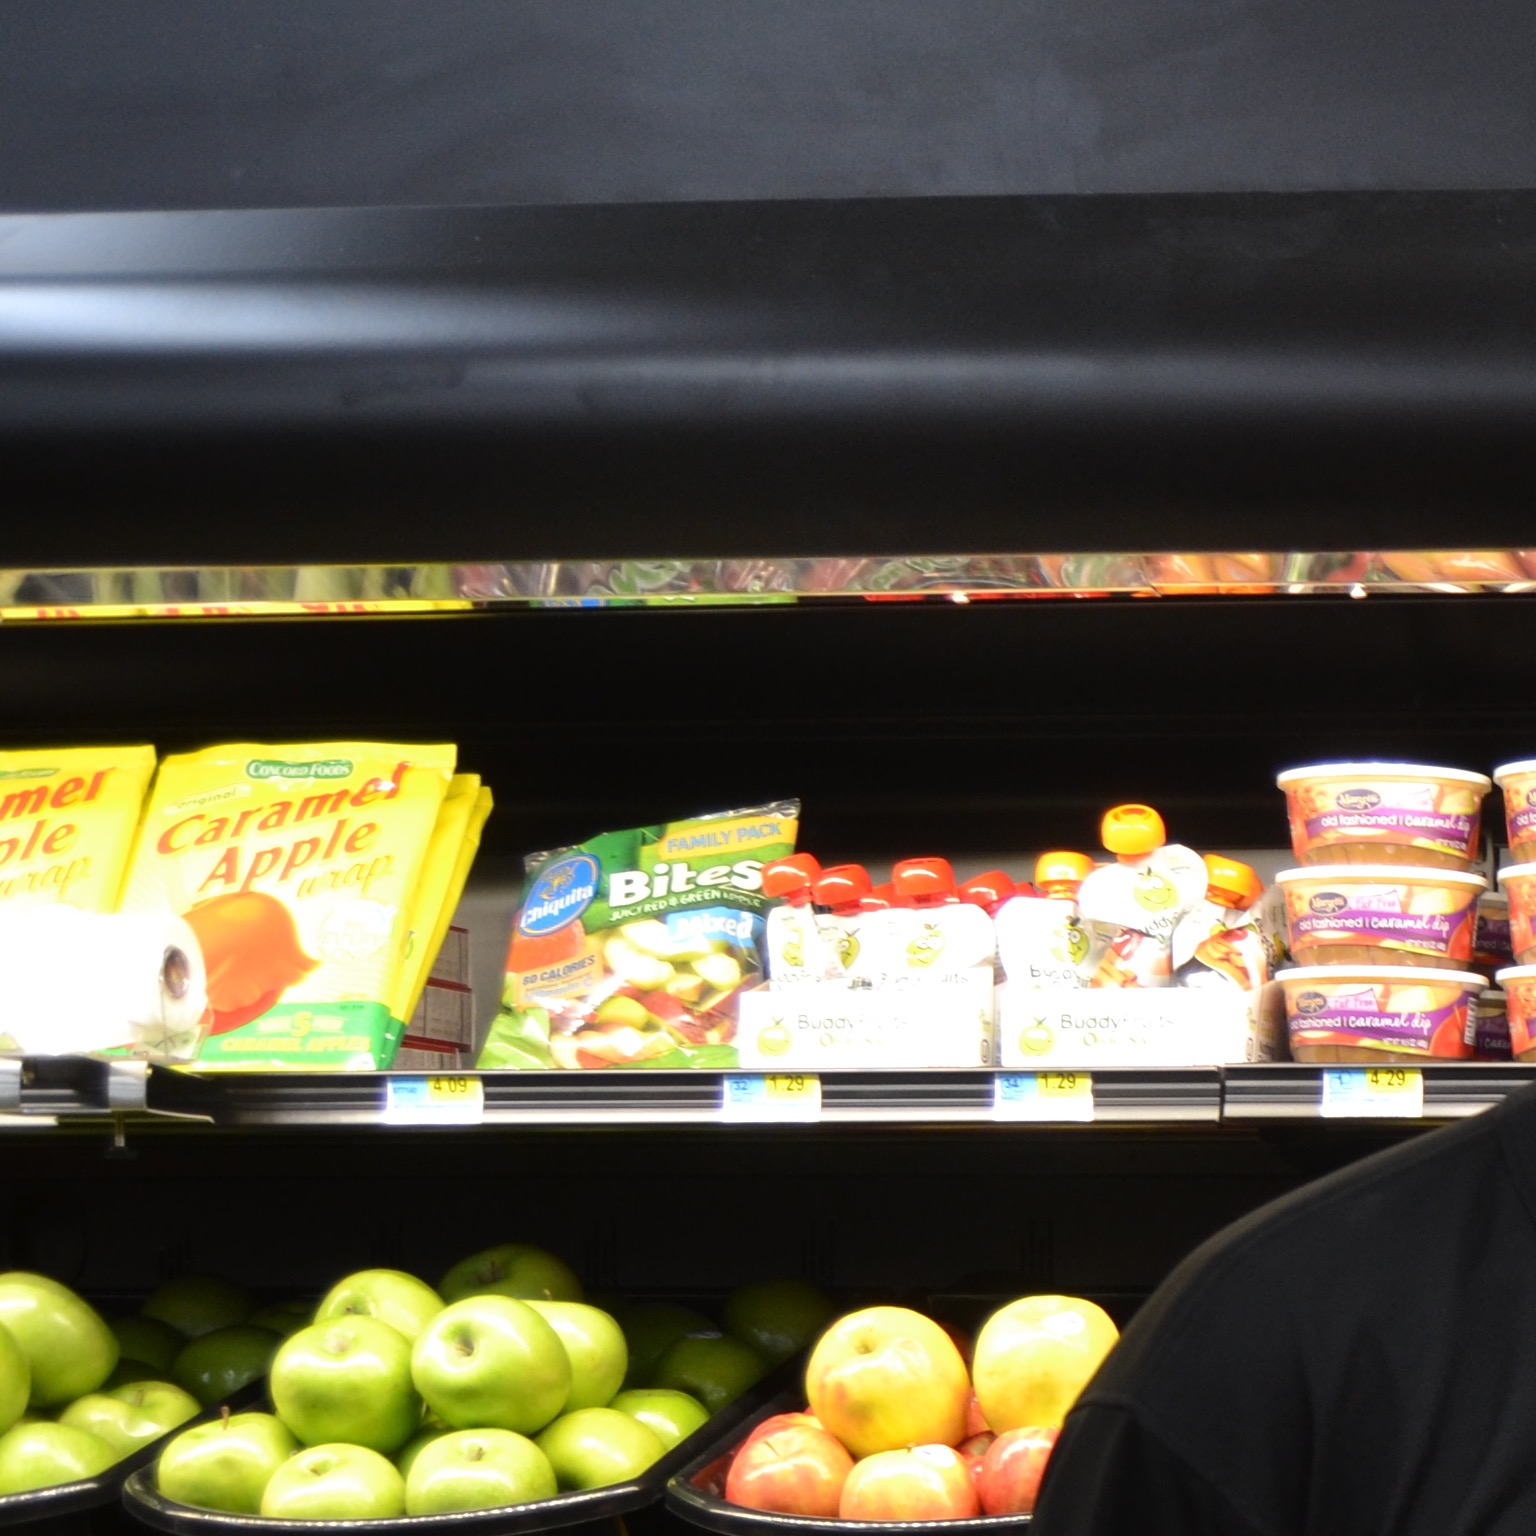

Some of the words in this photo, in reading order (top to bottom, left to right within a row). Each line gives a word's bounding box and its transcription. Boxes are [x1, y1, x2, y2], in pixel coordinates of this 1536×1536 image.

[157, 760, 412, 855] Caramel
[1340, 814, 1397, 826] fashioned
[666, 829, 733, 853] FAMILY
[736, 822, 782, 843] PACK
[197, 820, 377, 893] Apple
[609, 861, 764, 907] Bites
[521, 882, 594, 927] Chiquita
[643, 900, 667, 913] RED
[680, 890, 720, 904] GREEN
[678, 909, 753, 939] Mixed
[1311, 916, 1364, 930] fashioned
[1409, 1011, 1431, 1037] dip
